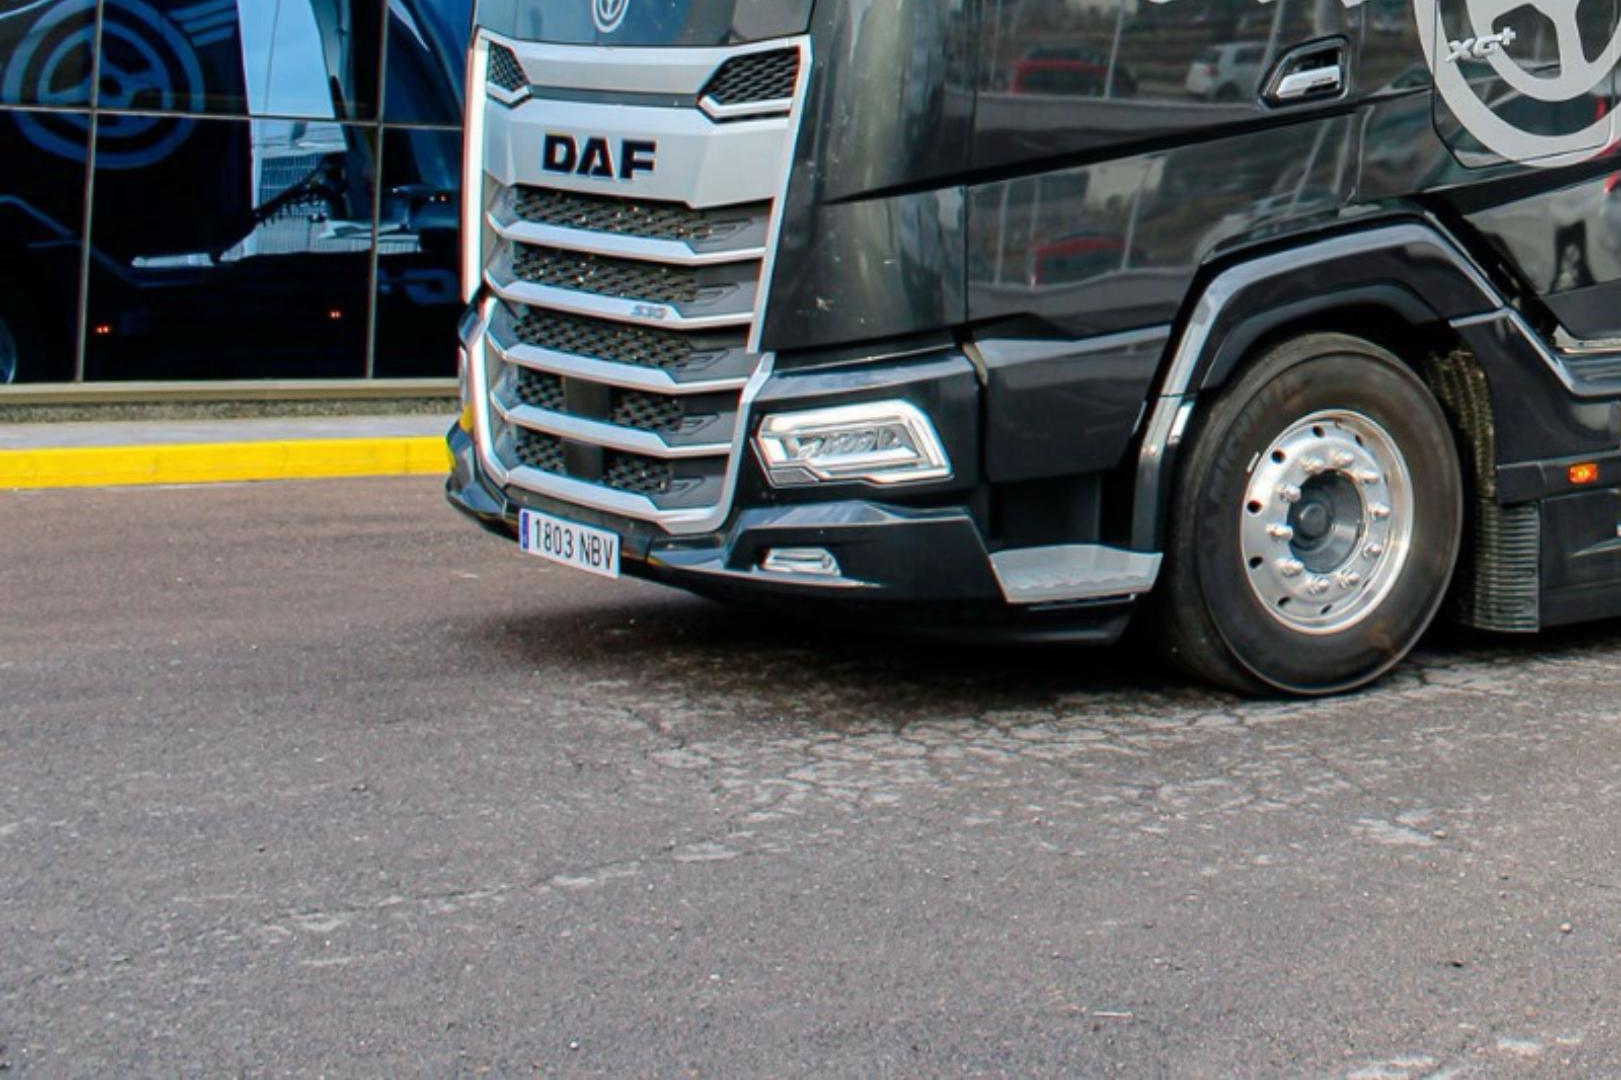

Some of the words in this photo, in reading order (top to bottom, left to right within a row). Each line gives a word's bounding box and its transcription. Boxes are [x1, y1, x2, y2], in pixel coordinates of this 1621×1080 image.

[542, 133, 657, 179] DAF
[534, 519, 575, 559] 1803
[579, 531, 614, 570] NBV
